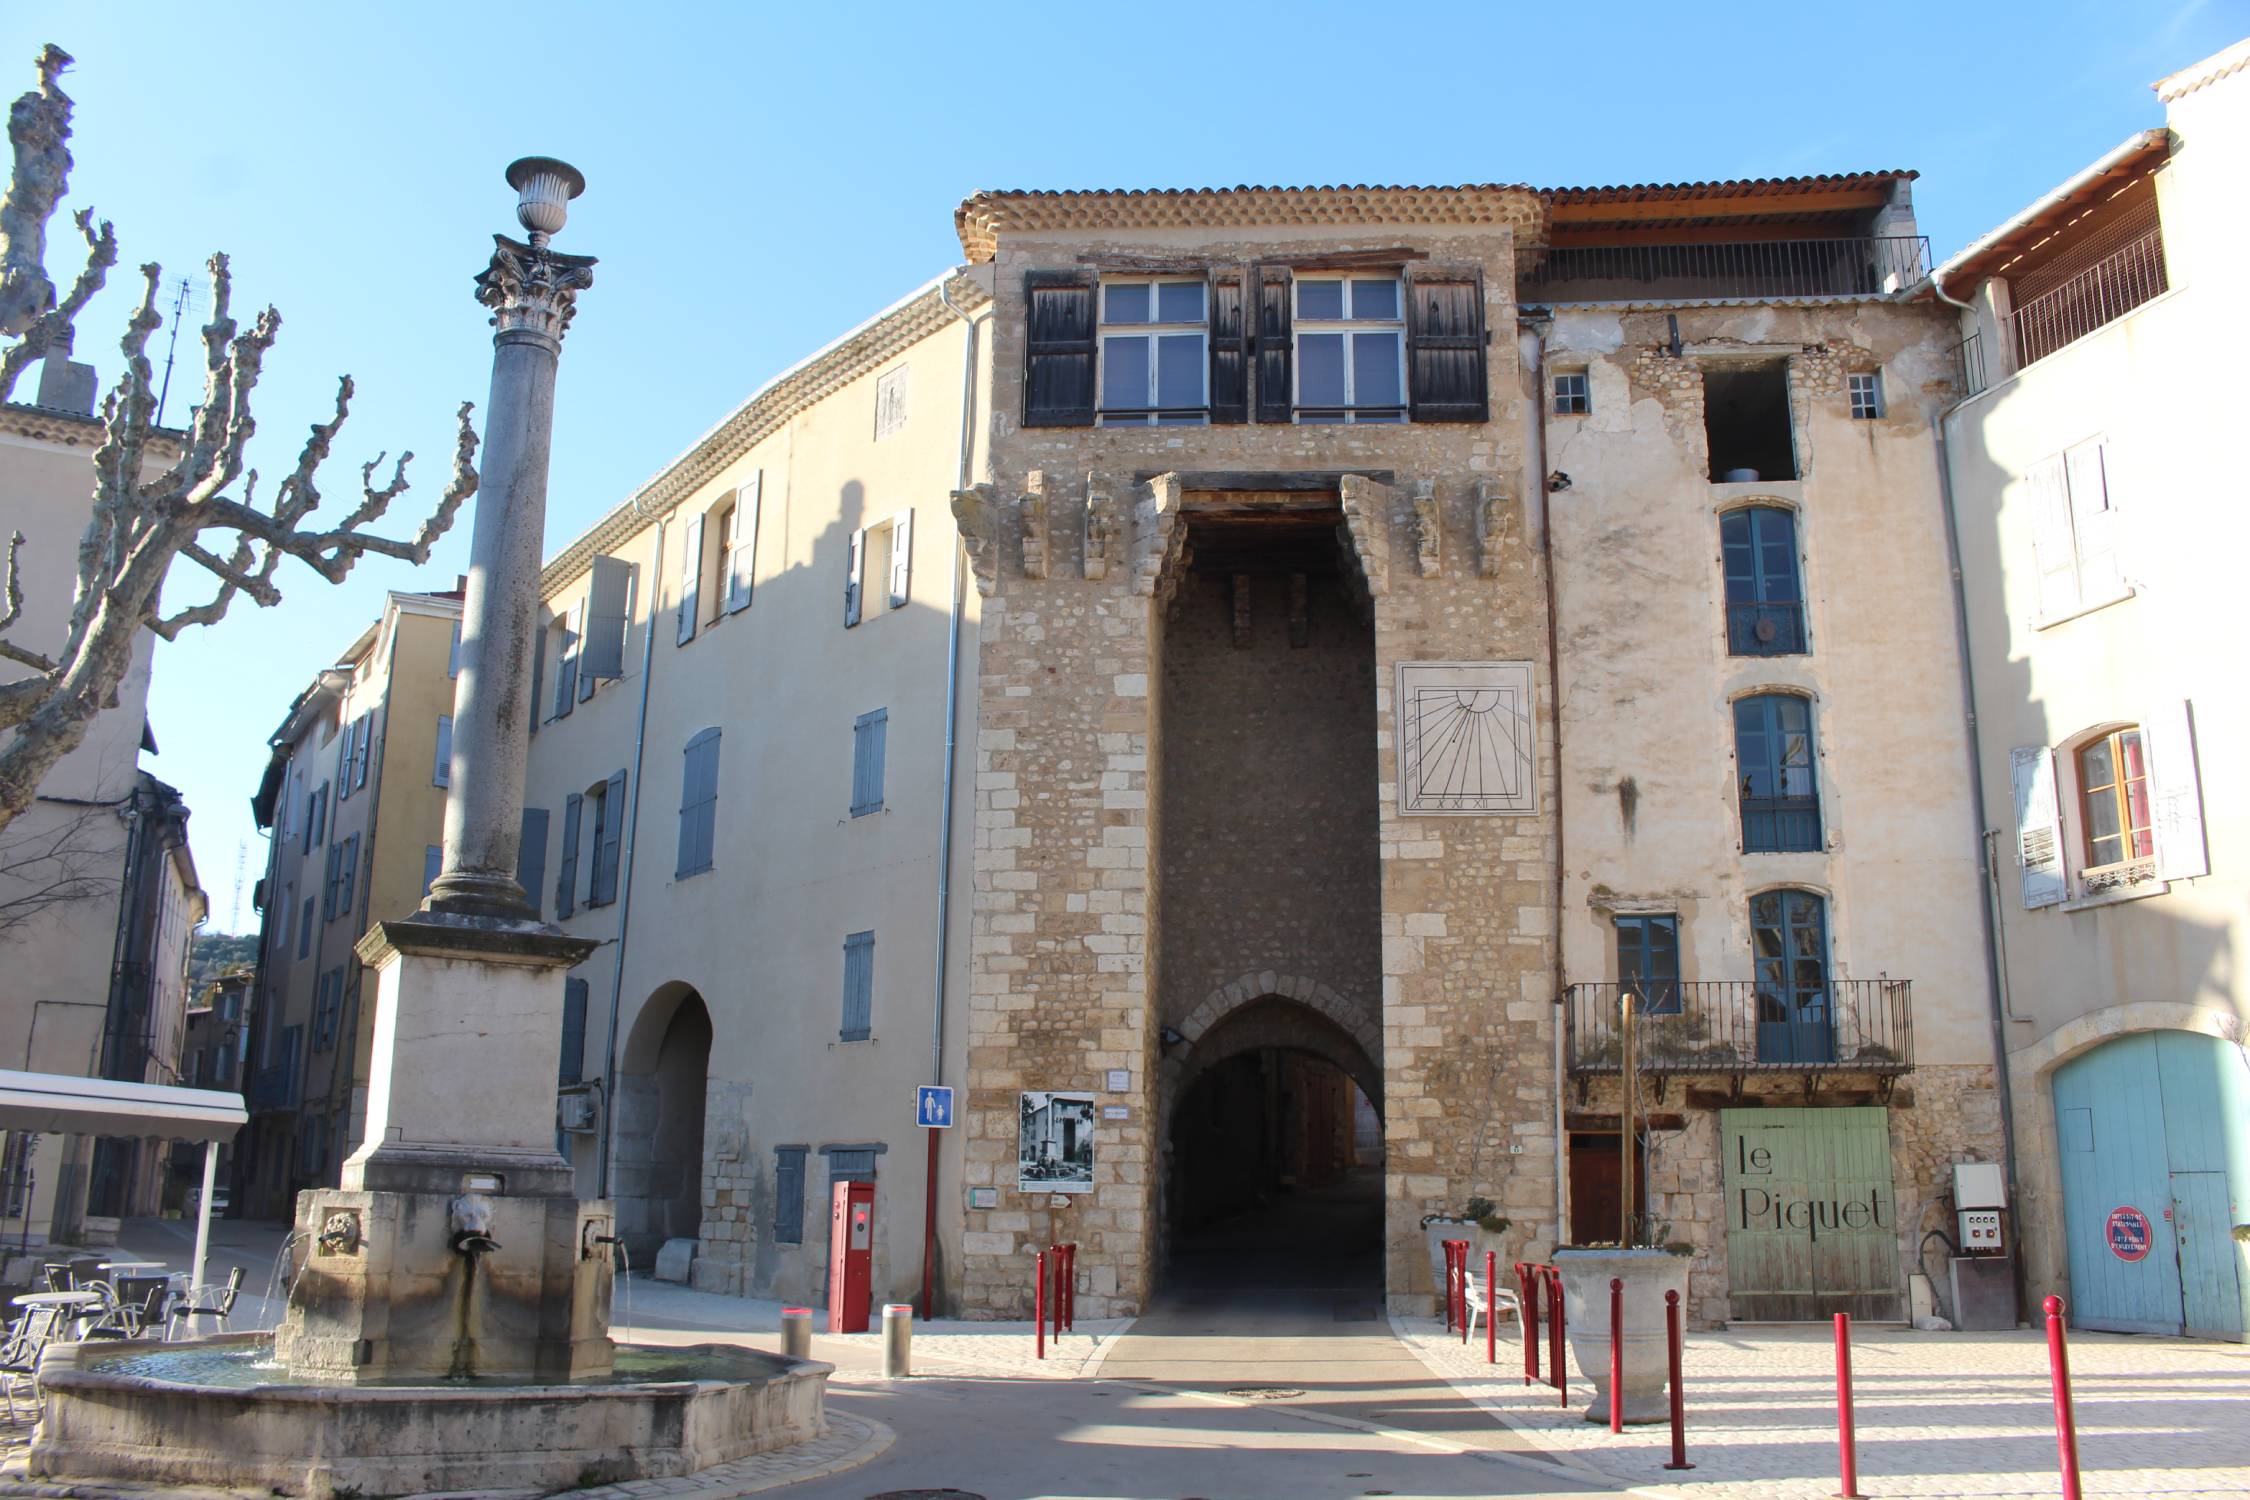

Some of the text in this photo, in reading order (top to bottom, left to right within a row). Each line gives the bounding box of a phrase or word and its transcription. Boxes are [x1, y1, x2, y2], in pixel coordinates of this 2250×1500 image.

[1472, 799, 1489, 809] XII
[1738, 1135, 1773, 1175] Le
[1741, 1188, 1889, 1242] Piquet
